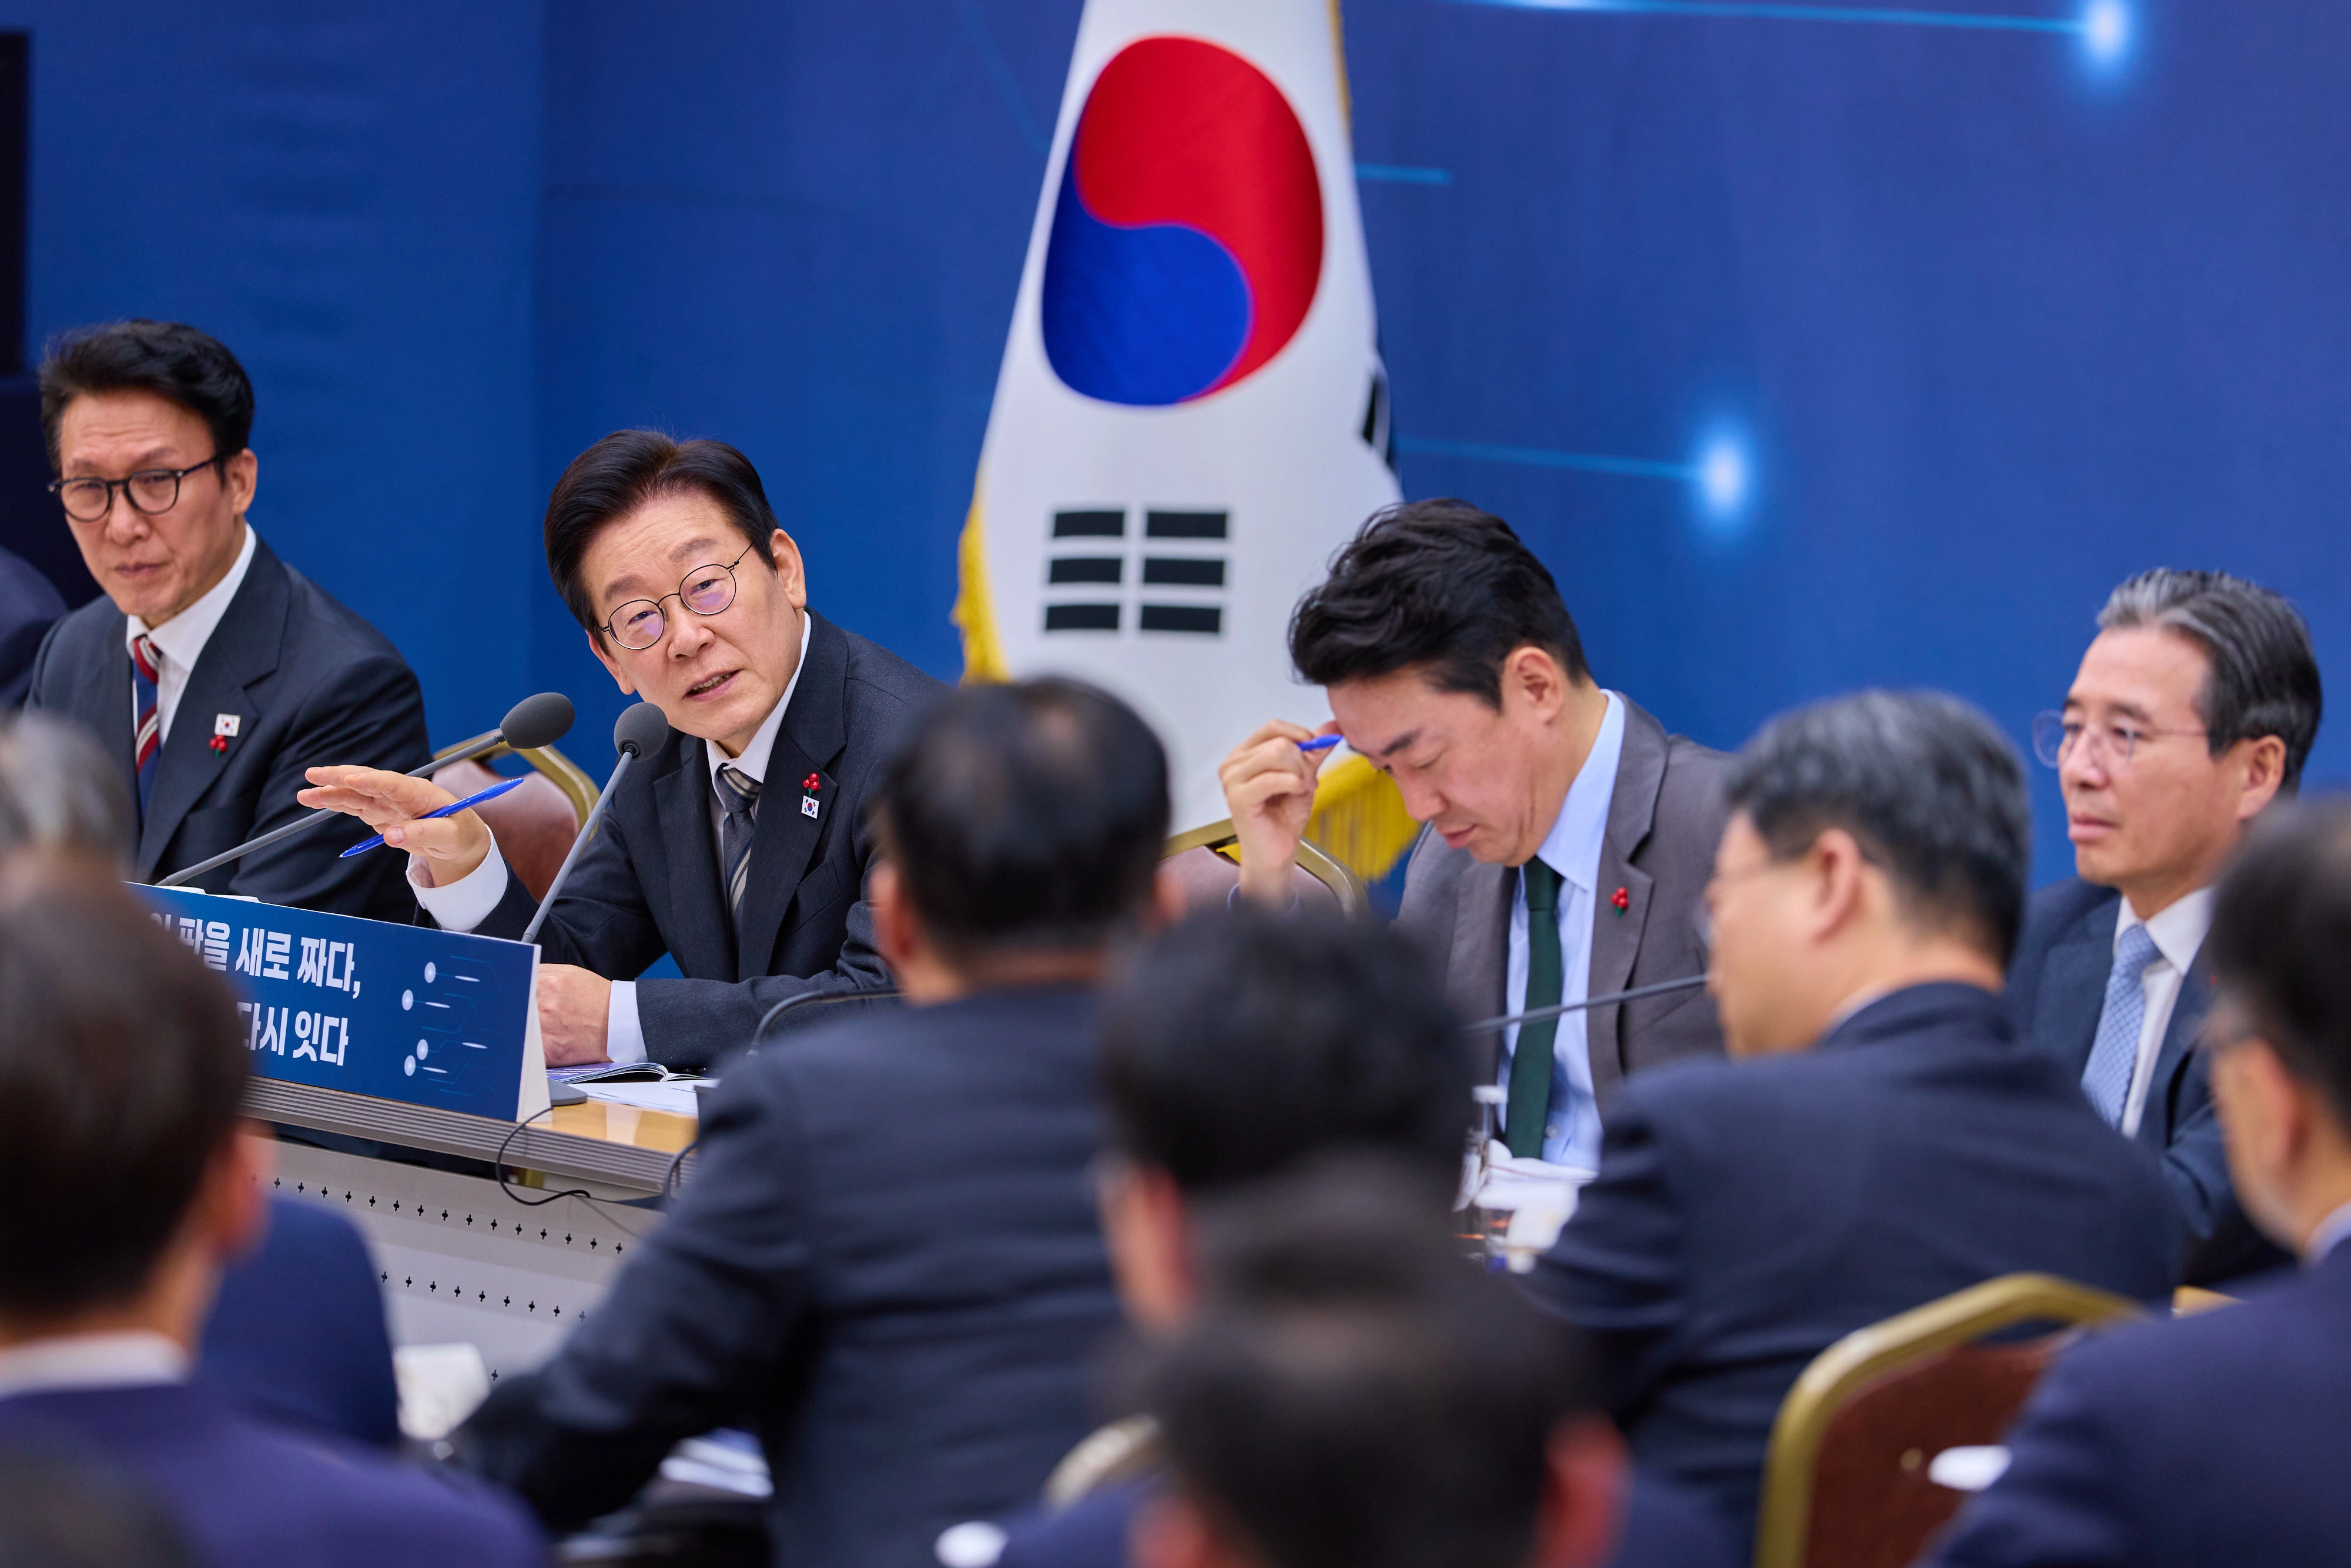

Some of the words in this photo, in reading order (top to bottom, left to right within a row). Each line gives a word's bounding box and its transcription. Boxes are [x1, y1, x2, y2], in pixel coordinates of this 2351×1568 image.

[235, 928, 292, 980] 새로
[297, 937, 360, 999] 짜다,
[236, 1001, 289, 1056] 다시
[293, 1011, 349, 1066] 잇다
